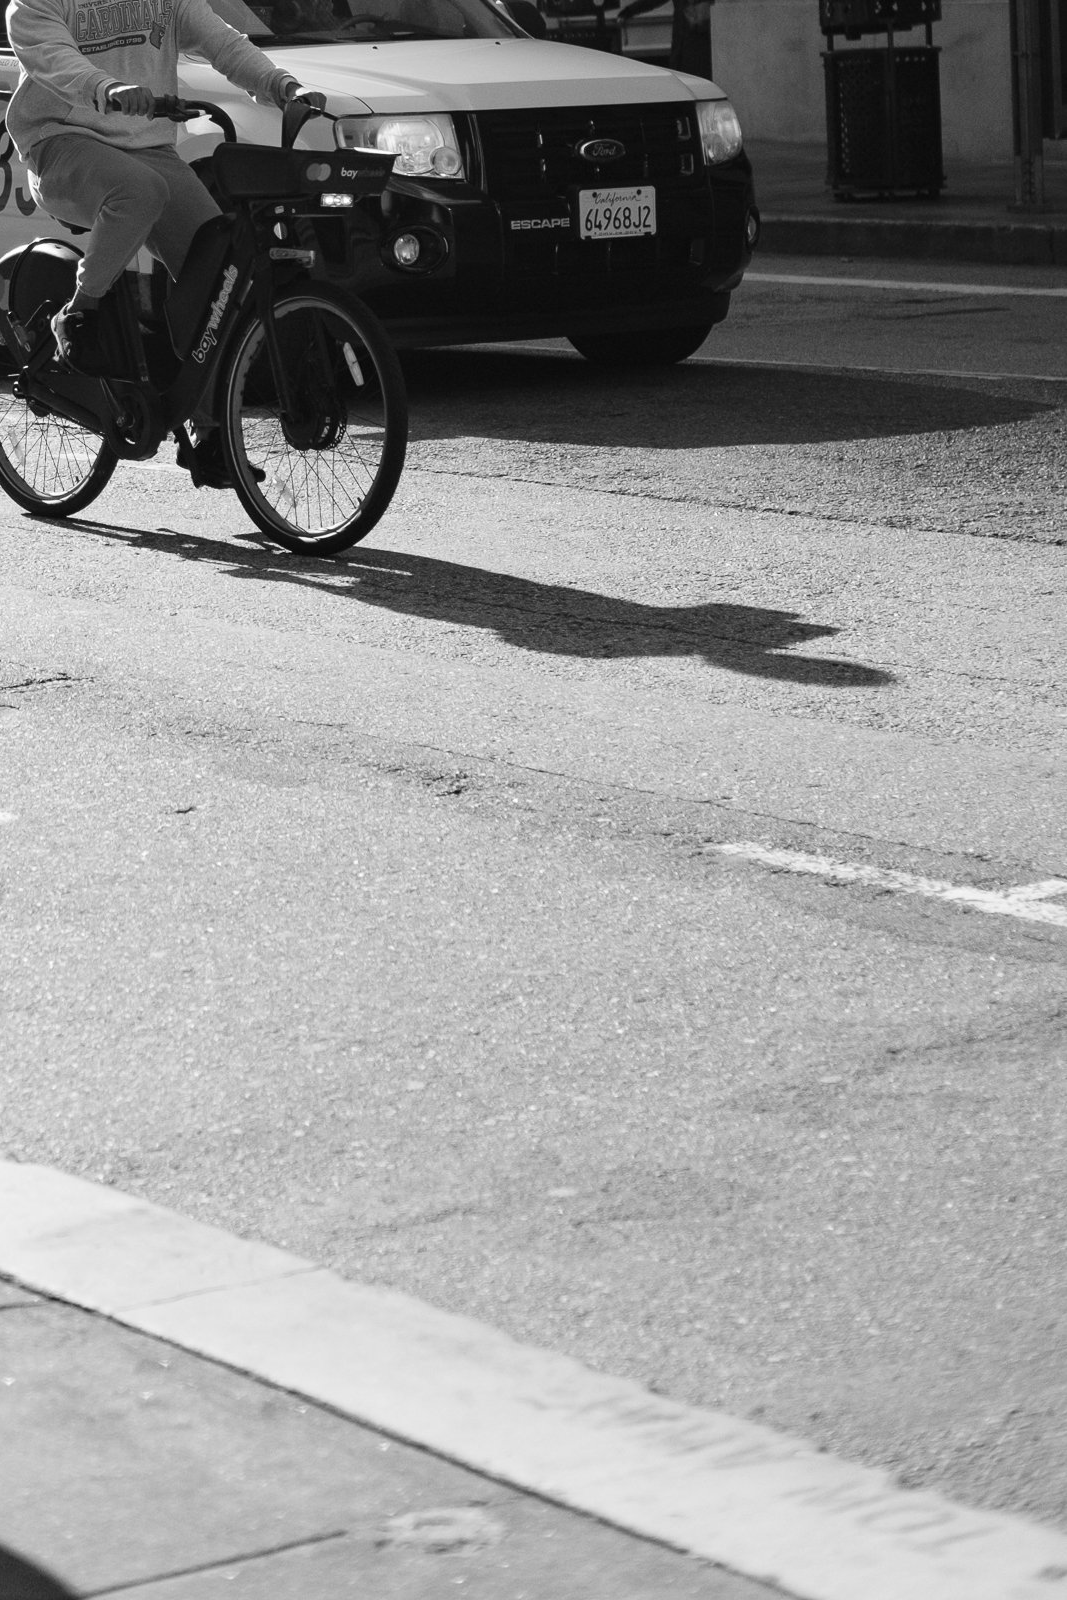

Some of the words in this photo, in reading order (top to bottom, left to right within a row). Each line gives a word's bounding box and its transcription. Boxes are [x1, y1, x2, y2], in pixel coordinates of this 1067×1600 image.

[81, 39, 125, 53] ESTABLISHED
[592, 143, 617, 157] Ford
[595, 191, 640, 207] California
[510, 218, 570, 231] ESCAPE
[584, 205, 652, 232] 64968J2
